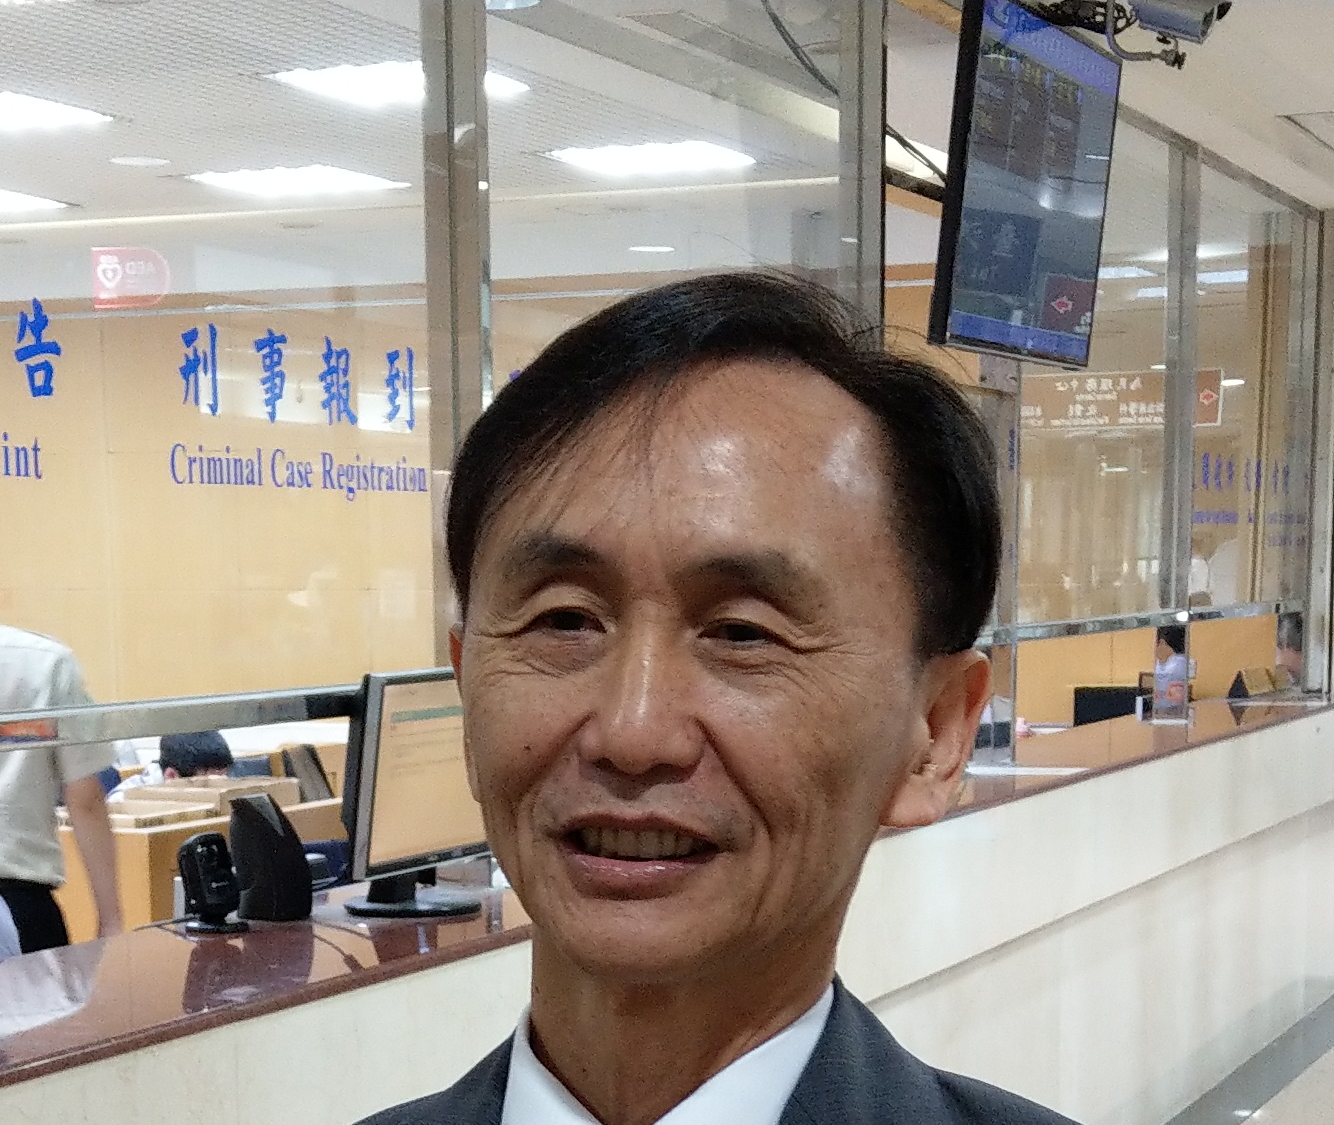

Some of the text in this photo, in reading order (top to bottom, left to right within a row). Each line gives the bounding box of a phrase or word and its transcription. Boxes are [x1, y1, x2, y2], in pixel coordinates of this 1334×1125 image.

[178, 322, 416, 431] 刑事報到
[169, 443, 429, 502] Criminal Case Registration
